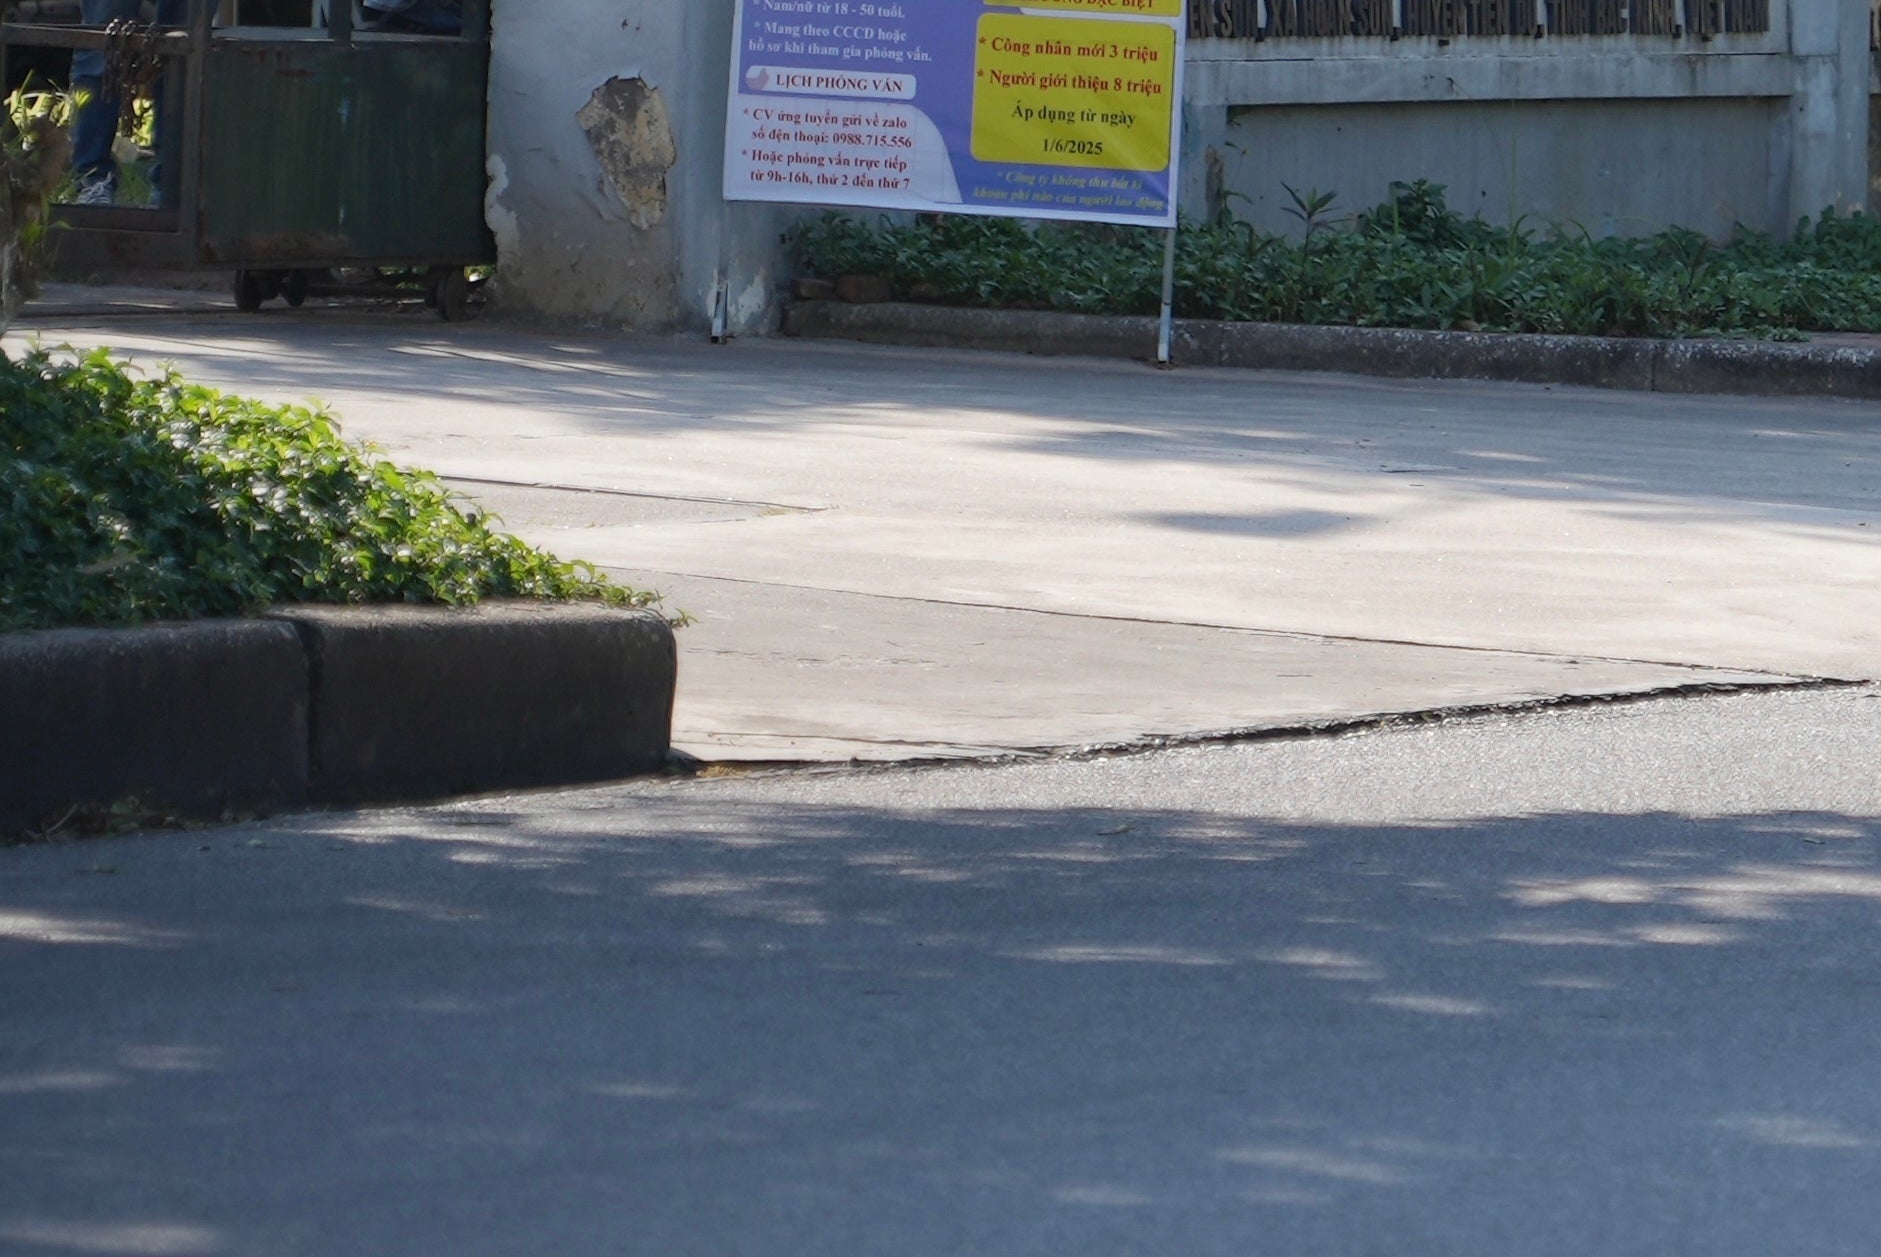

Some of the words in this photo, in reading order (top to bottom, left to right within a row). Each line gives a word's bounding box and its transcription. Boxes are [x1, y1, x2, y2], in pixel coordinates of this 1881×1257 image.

[991, 36, 1031, 55] Công
[1035, 39, 1071, 55] nhân
[1077, 43, 1105, 57] mới
[1109, 45, 1117, 58] 3
[1123, 45, 1158, 64] triệu
[776, 73, 811, 89] LỊCH
[871, 74, 903, 92] VẤN
[989, 68, 1035, 89] Người
[1039, 72, 1067, 91] giới
[1071, 74, 1109, 93] thiệu
[1113, 77, 1121, 91] 8
[1126, 78, 1162, 97] triệu
[752, 108, 774, 120] CV
[1011, 99, 1034, 121] Áp
[1037, 104, 1076, 124] dụng
[1080, 107, 1097, 122] từ
[1100, 108, 1136, 128] ngày
[832, 134, 912, 148] 0988.715.556
[1042, 138, 1104, 155] 1/6/2025
[766, 170, 813, 185] 9h-16h,
